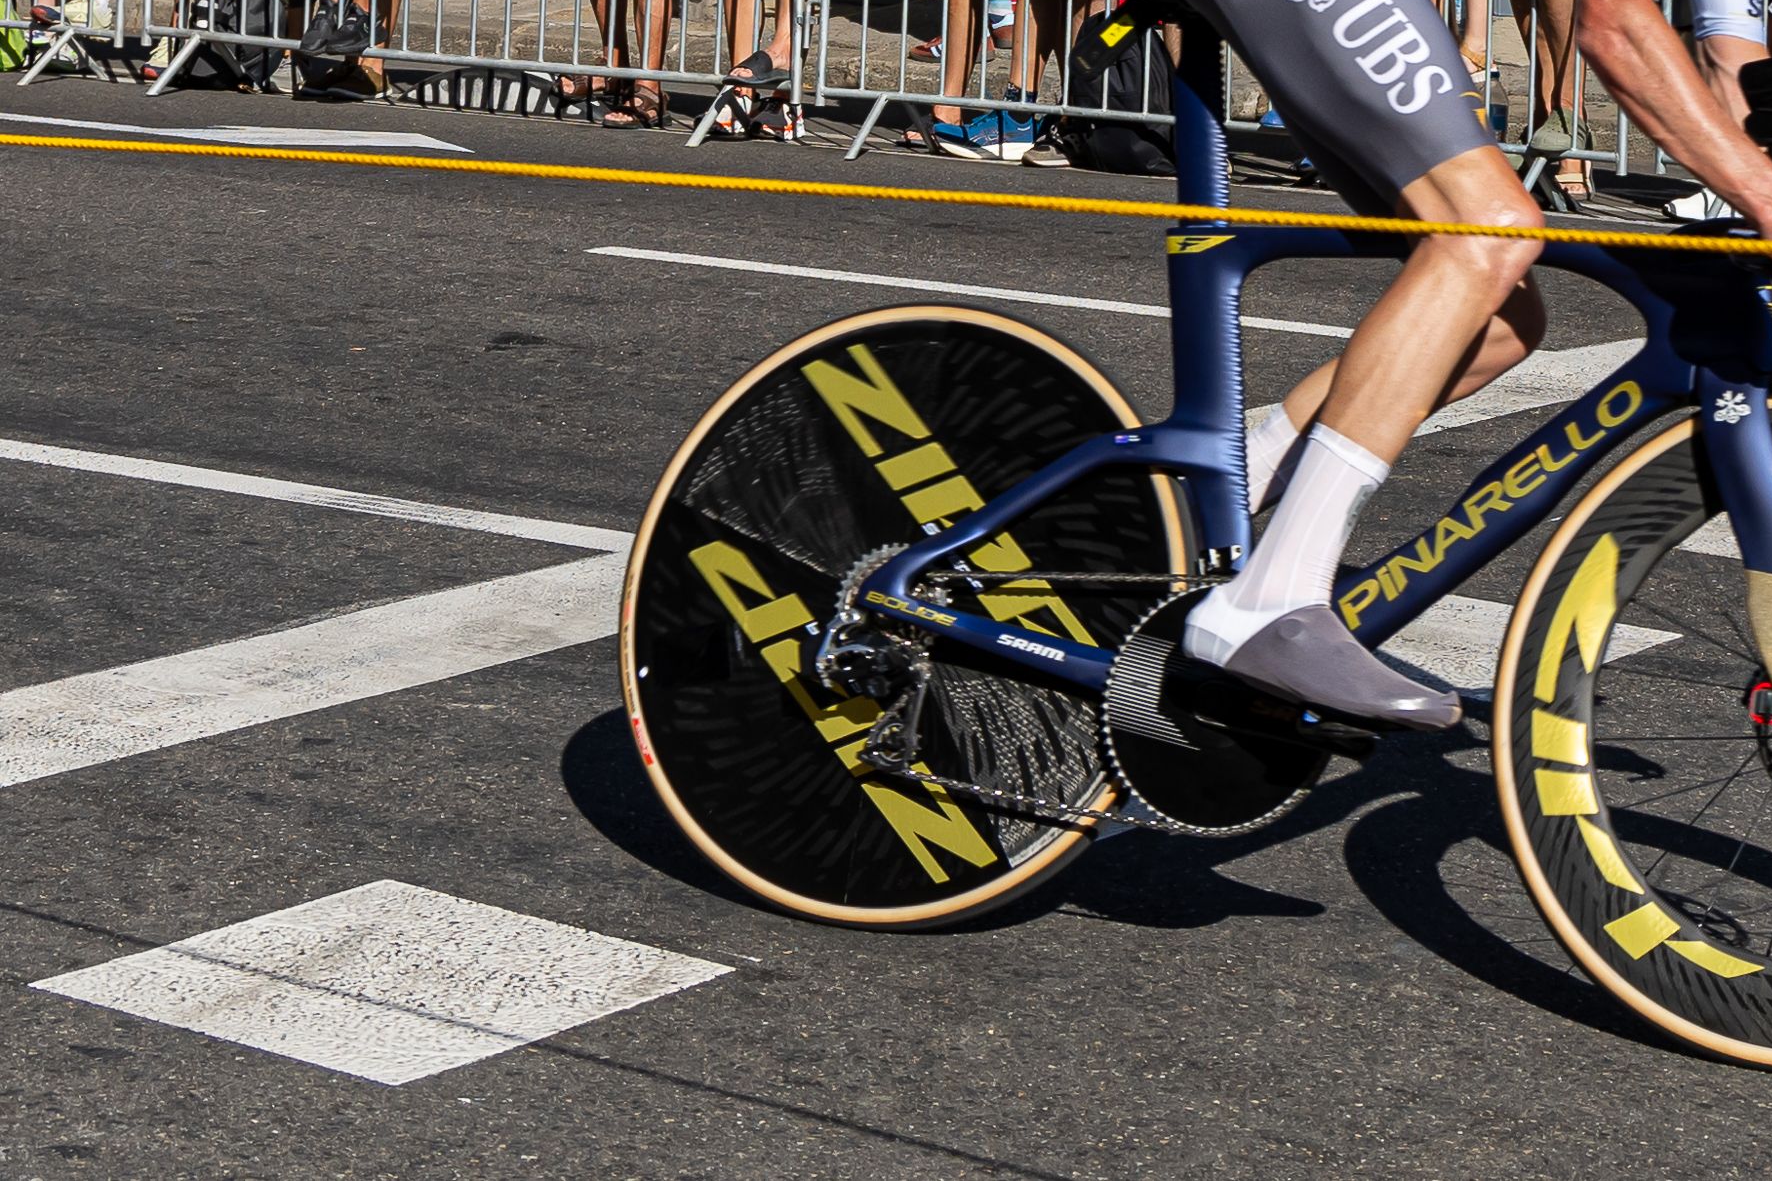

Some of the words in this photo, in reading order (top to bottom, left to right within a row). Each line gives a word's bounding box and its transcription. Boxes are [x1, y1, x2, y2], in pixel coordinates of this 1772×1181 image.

[1338, 380, 1643, 631] PINARELLO
[864, 590, 957, 626] BOLIDE
[996, 633, 1066, 662] SRAM
